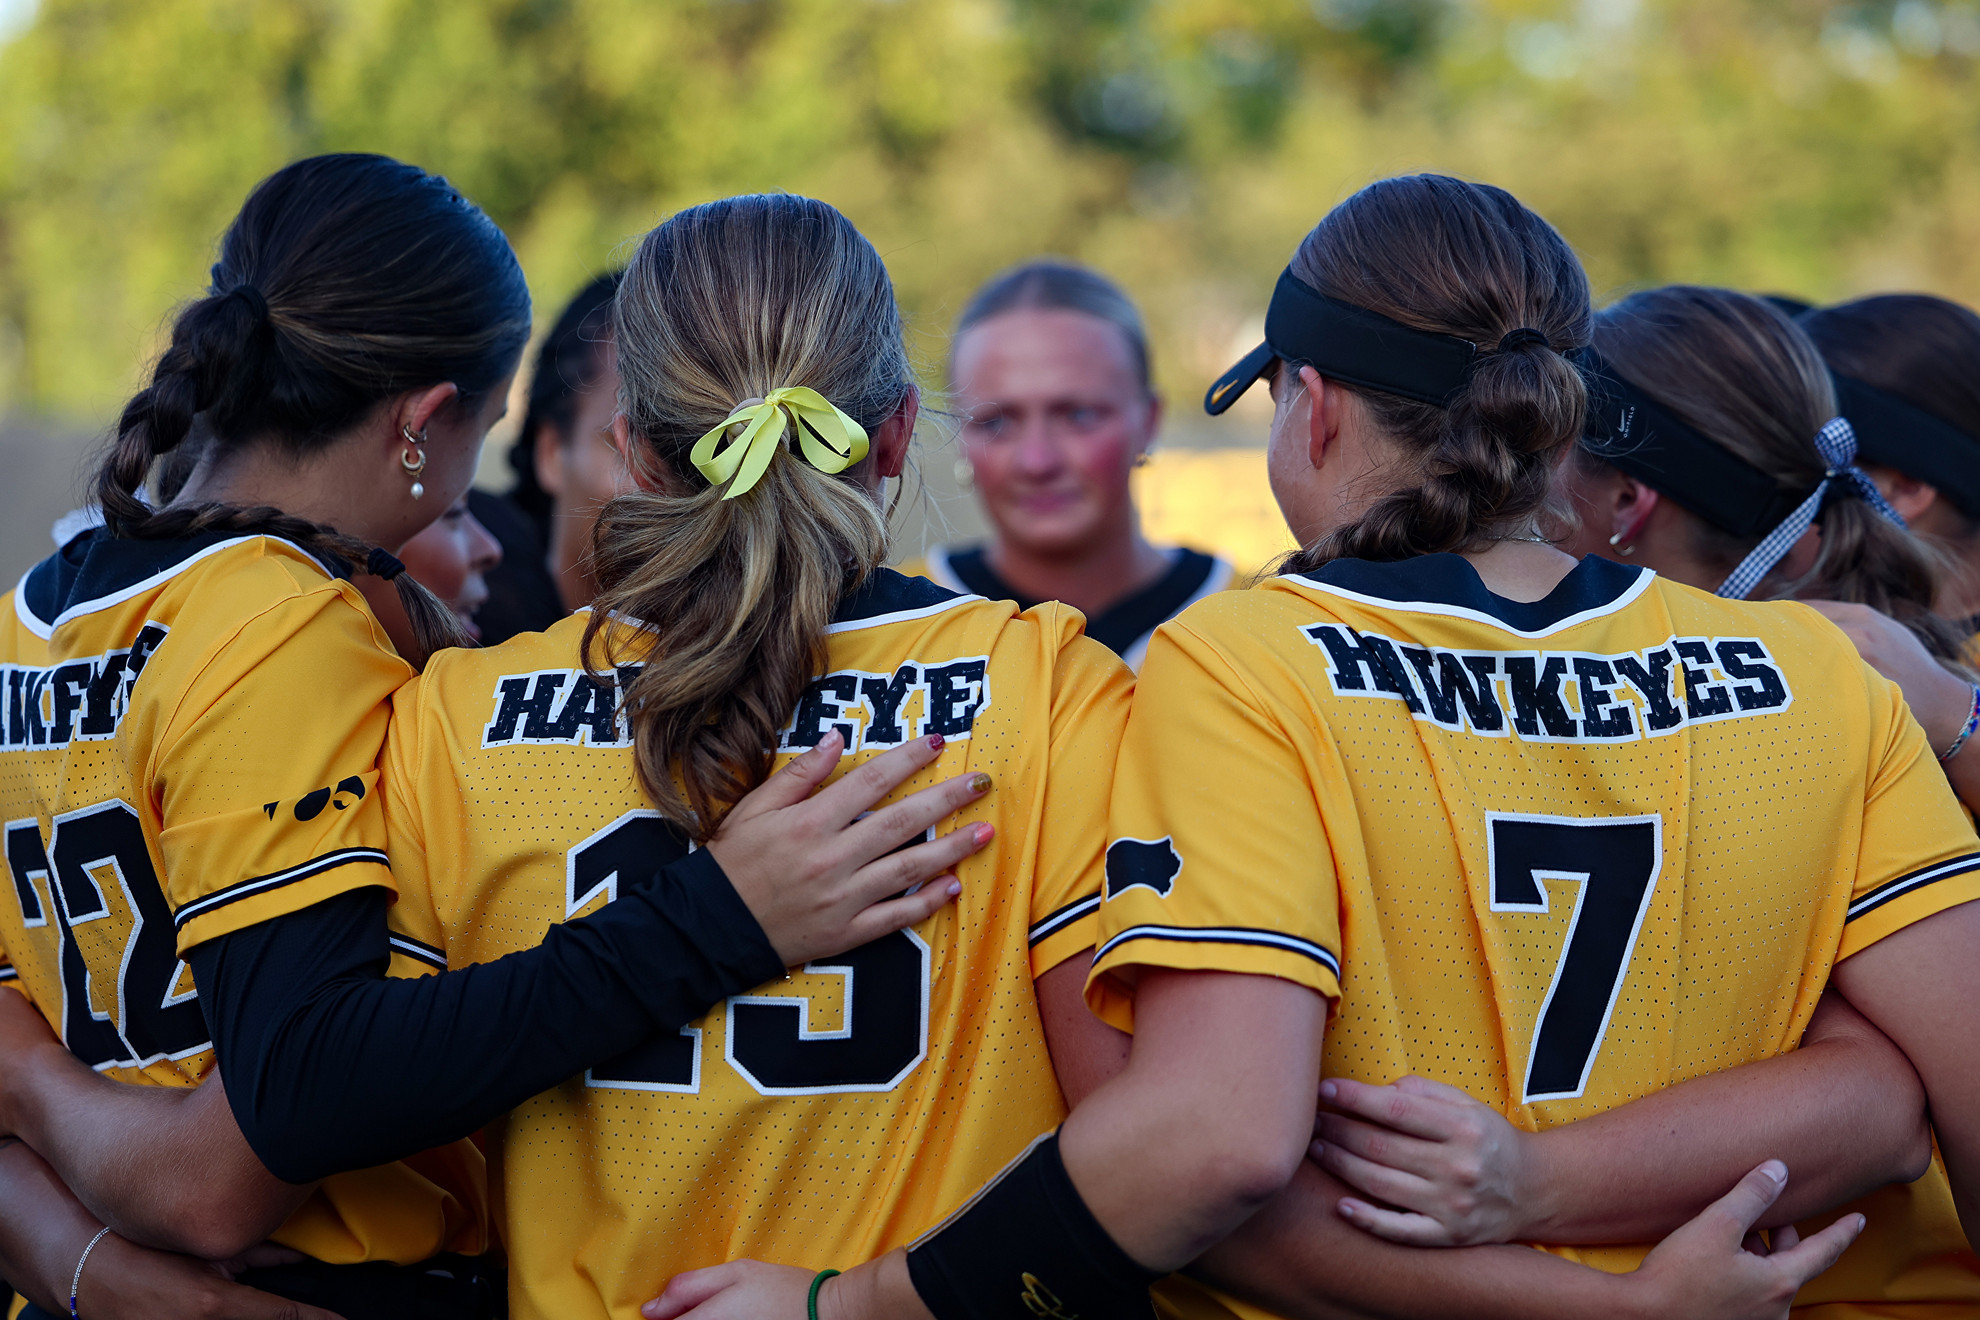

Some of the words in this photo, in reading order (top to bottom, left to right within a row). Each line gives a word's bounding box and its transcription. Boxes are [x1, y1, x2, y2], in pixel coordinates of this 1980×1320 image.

[481, 655, 992, 755] HAEYE
[4, 798, 214, 1072] 22
[1484, 810, 1663, 1104] 7
